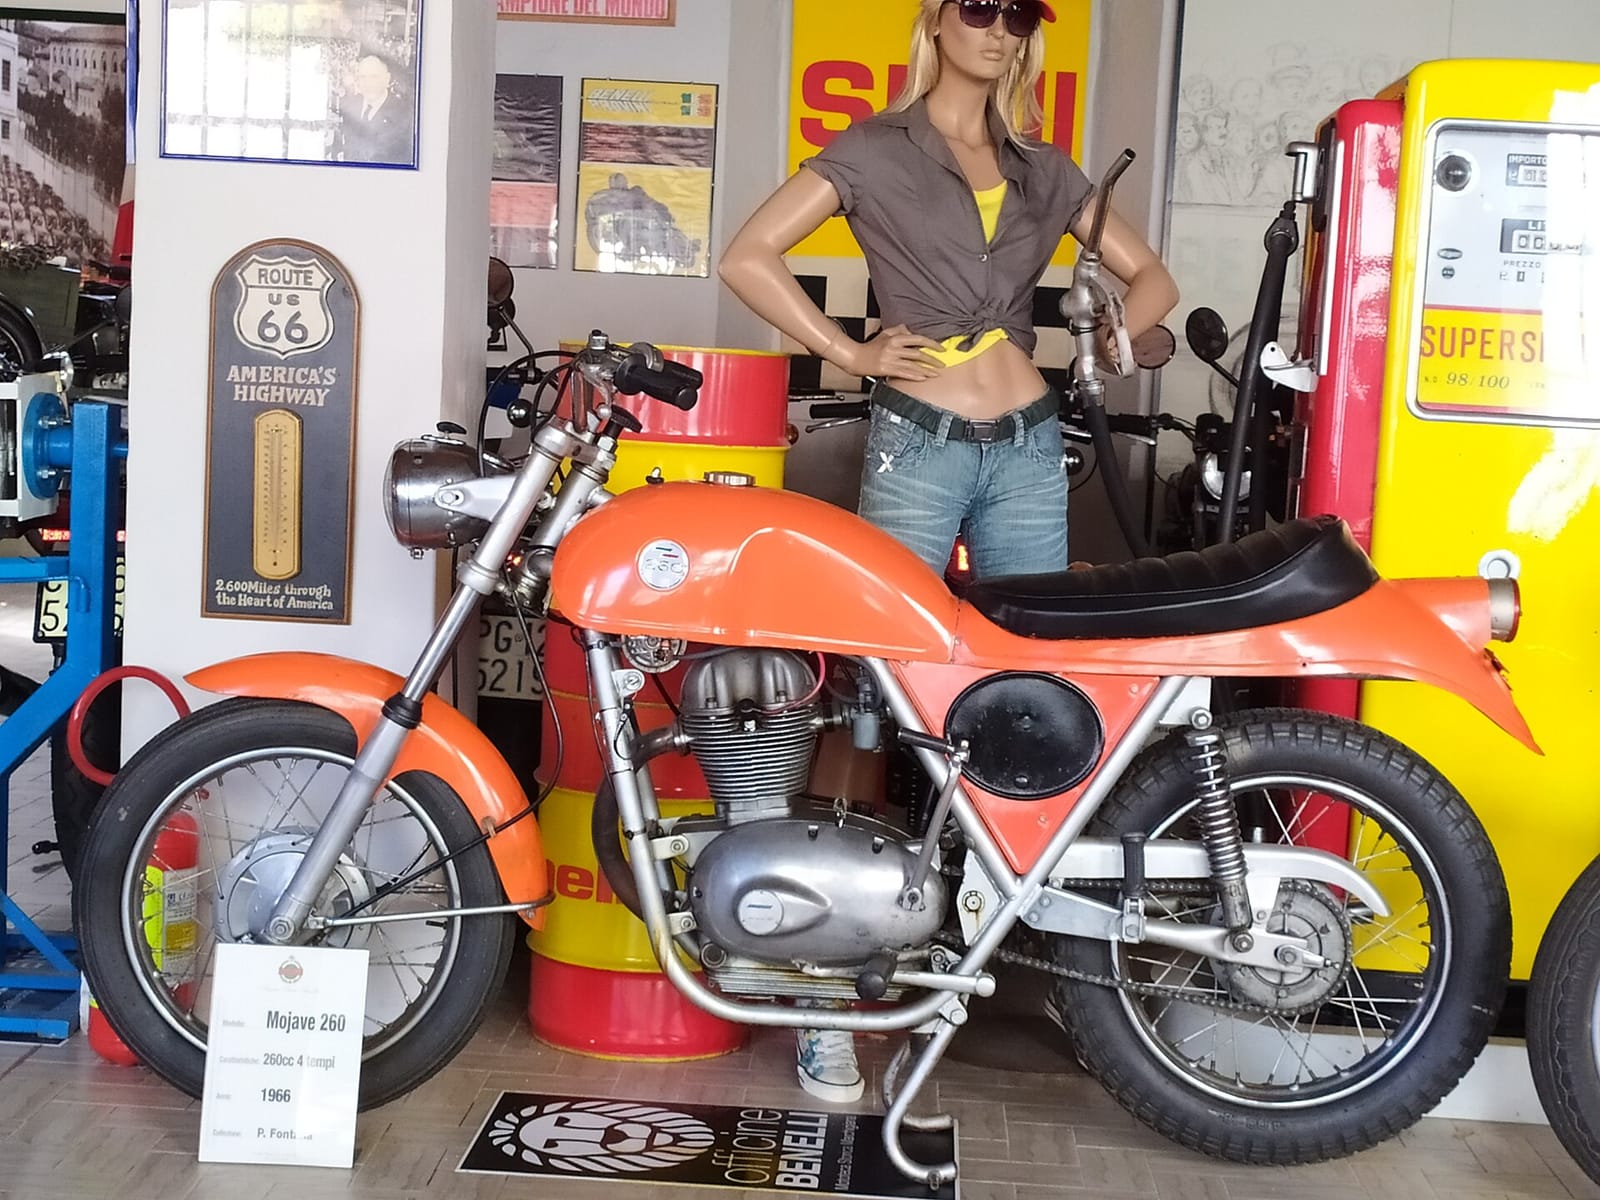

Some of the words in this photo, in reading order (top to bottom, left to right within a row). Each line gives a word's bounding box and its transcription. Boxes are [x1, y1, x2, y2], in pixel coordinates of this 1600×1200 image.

[257, 268, 314, 286] ROUTE
[257, 309, 308, 344] 66
[1420, 325, 1545, 364] SUPERS
[226, 364, 337, 386] AMERICA'S
[233, 384, 331, 408] HIGHWAY
[216, 591, 237, 606] the
[237, 593, 273, 608] Heart
[273, 595, 287, 609] of
[286, 596, 334, 611] America
[284, 584, 332, 601] through
[267, 1011, 315, 1034] Mojave
[320, 1013, 346, 1032] 260
[263, 1053, 294, 1067] 260cc
[296, 1053, 303, 1067] 4
[261, 1088, 292, 1103] 1966
[257, 1128, 266, 1139] P.
[711, 1108, 783, 1185] officine
[775, 1111, 829, 1190] BENELLI
